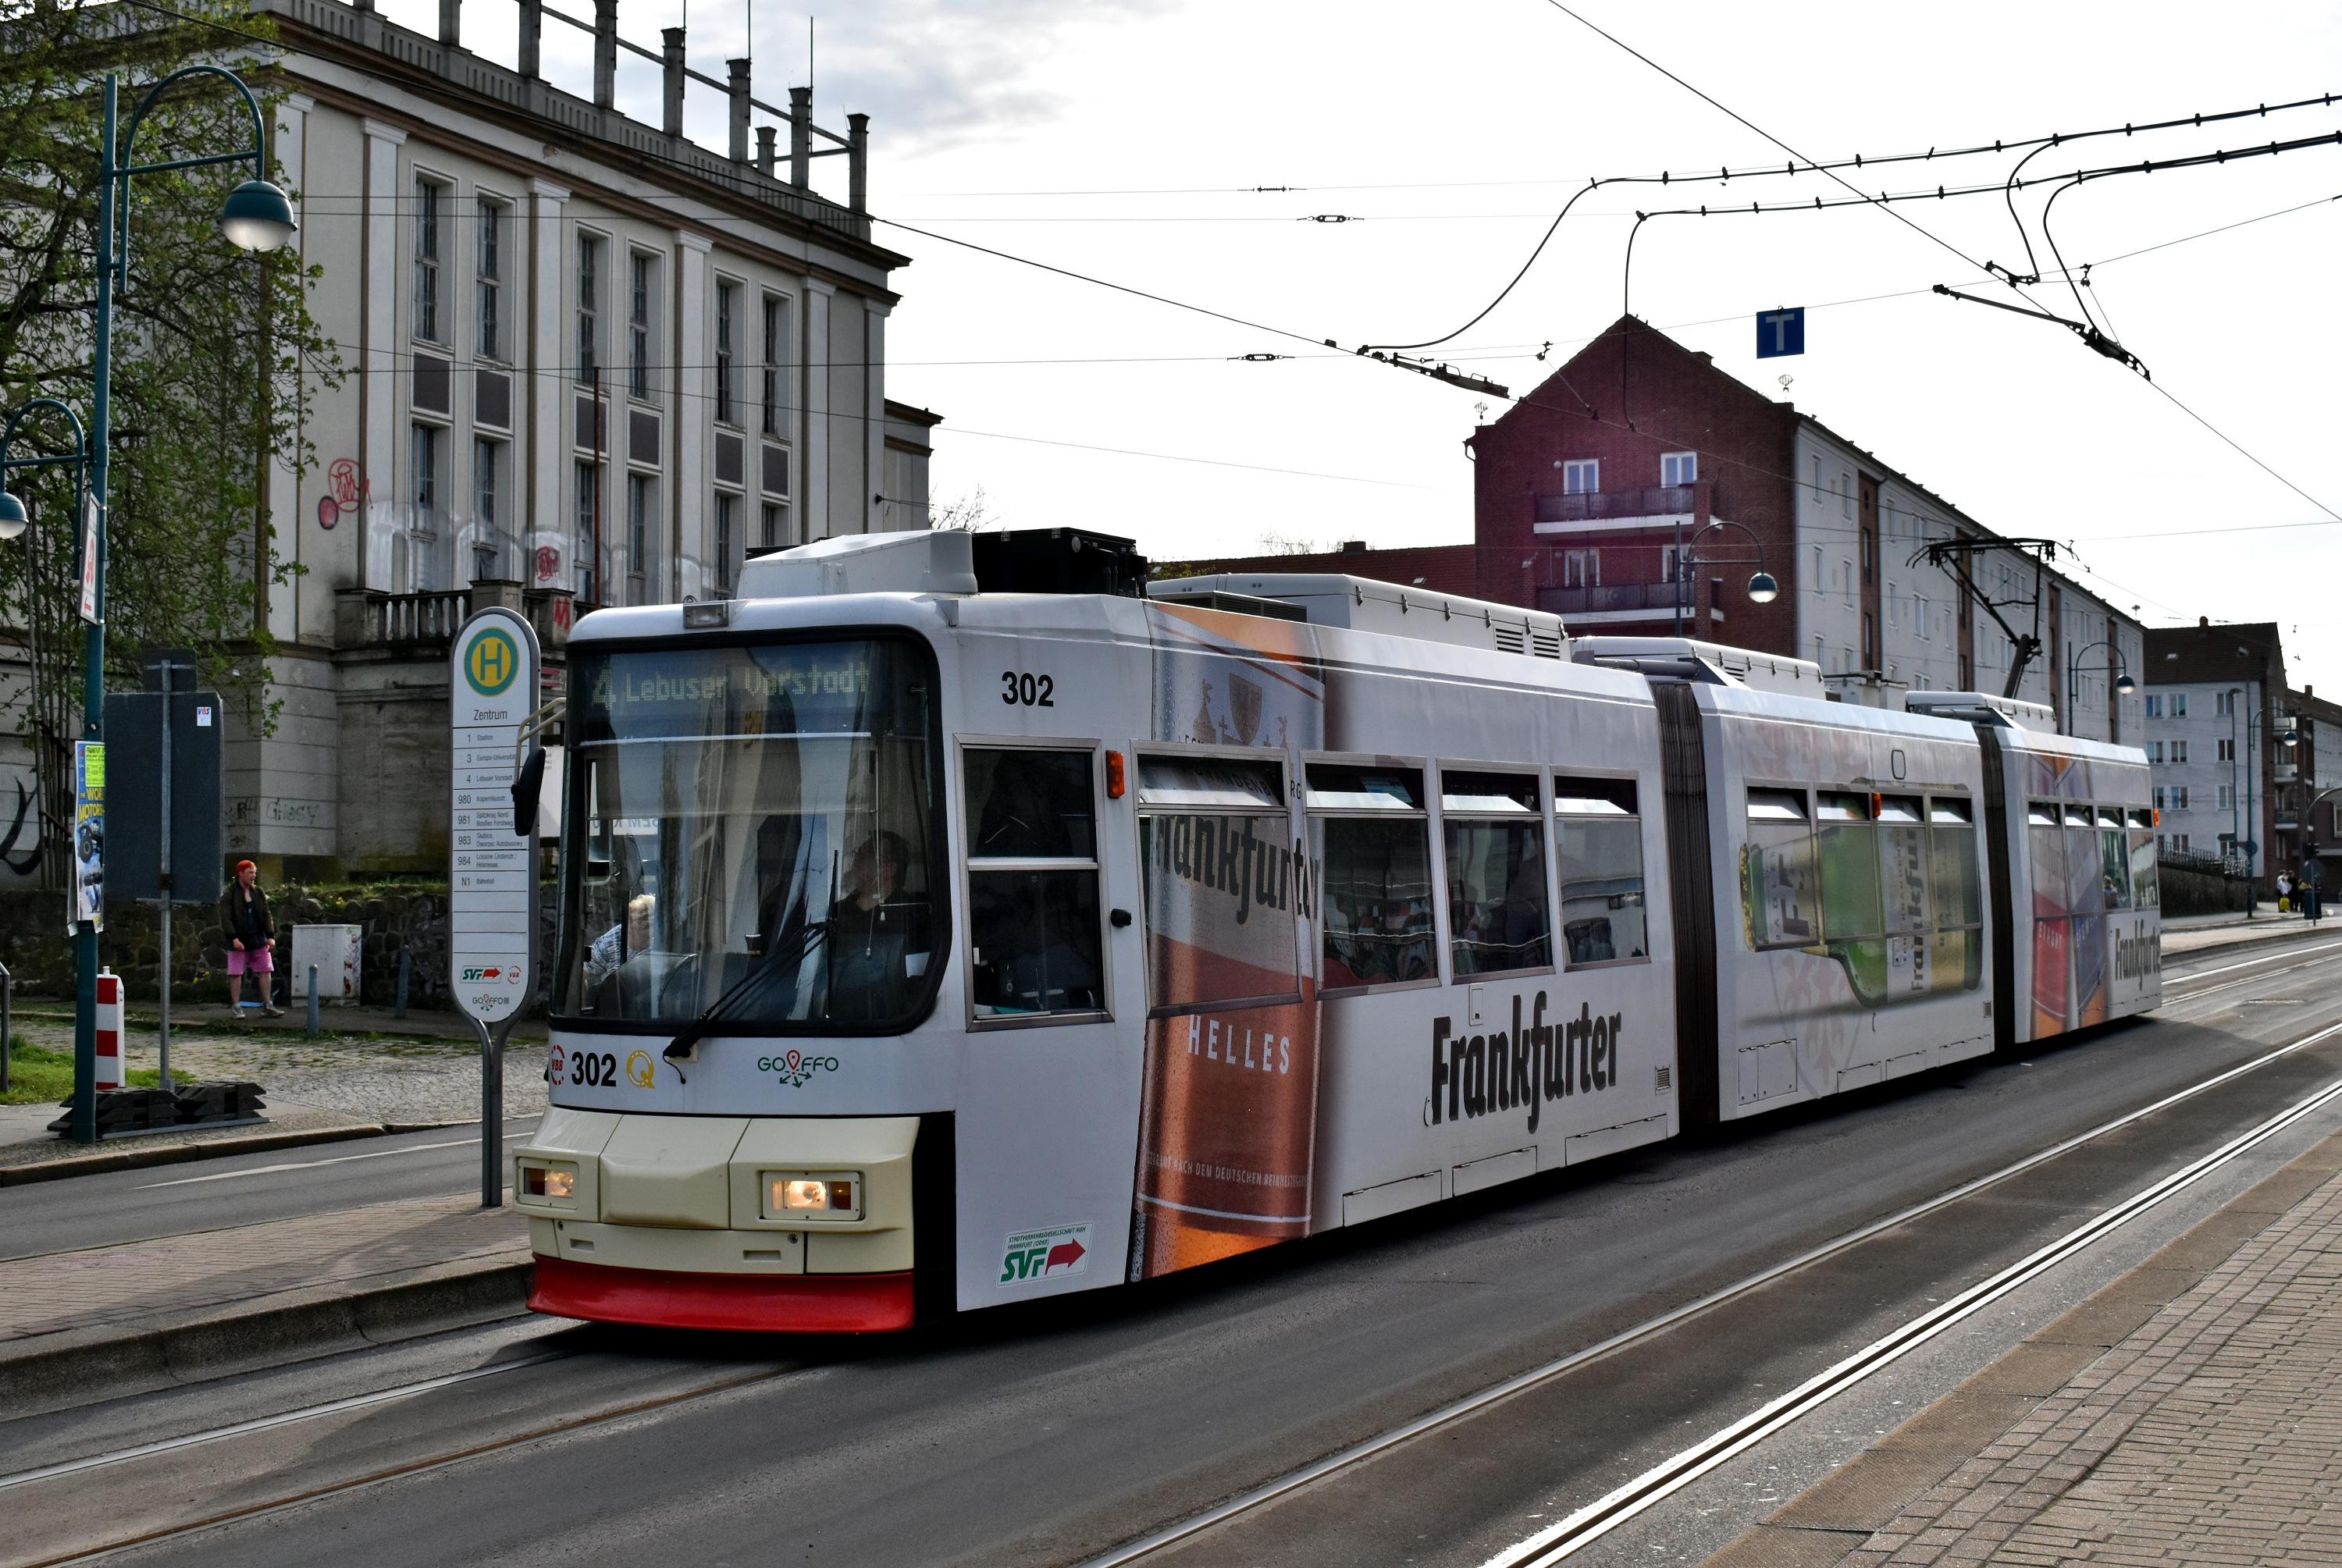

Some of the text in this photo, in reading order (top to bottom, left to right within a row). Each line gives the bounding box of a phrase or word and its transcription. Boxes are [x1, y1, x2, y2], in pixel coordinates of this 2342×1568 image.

[1766, 313, 1795, 351] T
[480, 643, 502, 681] H
[593, 661, 870, 711] 4 Lebuser Vorstadt
[1002, 671, 1054, 707] 302
[474, 709, 508, 721] Zentrum
[467, 754, 472, 763] 3
[466, 774, 471, 783] 4
[458, 795, 472, 804] 980
[458, 815, 471, 824] 981
[458, 836, 472, 845] 983
[458, 856, 471, 866] 984
[462, 877, 471, 887] N1
[462, 969, 483, 980] SVF
[1187, 1014, 1290, 1075] HELLES
[551, 1059, 563, 1072] VBB
[1432, 990, 1622, 1134] Frankfurter
[571, 1051, 617, 1087] 302
[1173, 1158, 1192, 1175] NACH
[1195, 1162, 1212, 1178] DEM
[1215, 1167, 1262, 1186] DEUTSCHEN
[1008, 1239, 1050, 1251] FRANKFURT (ODER)
[1001, 1247, 1048, 1282] SVF
